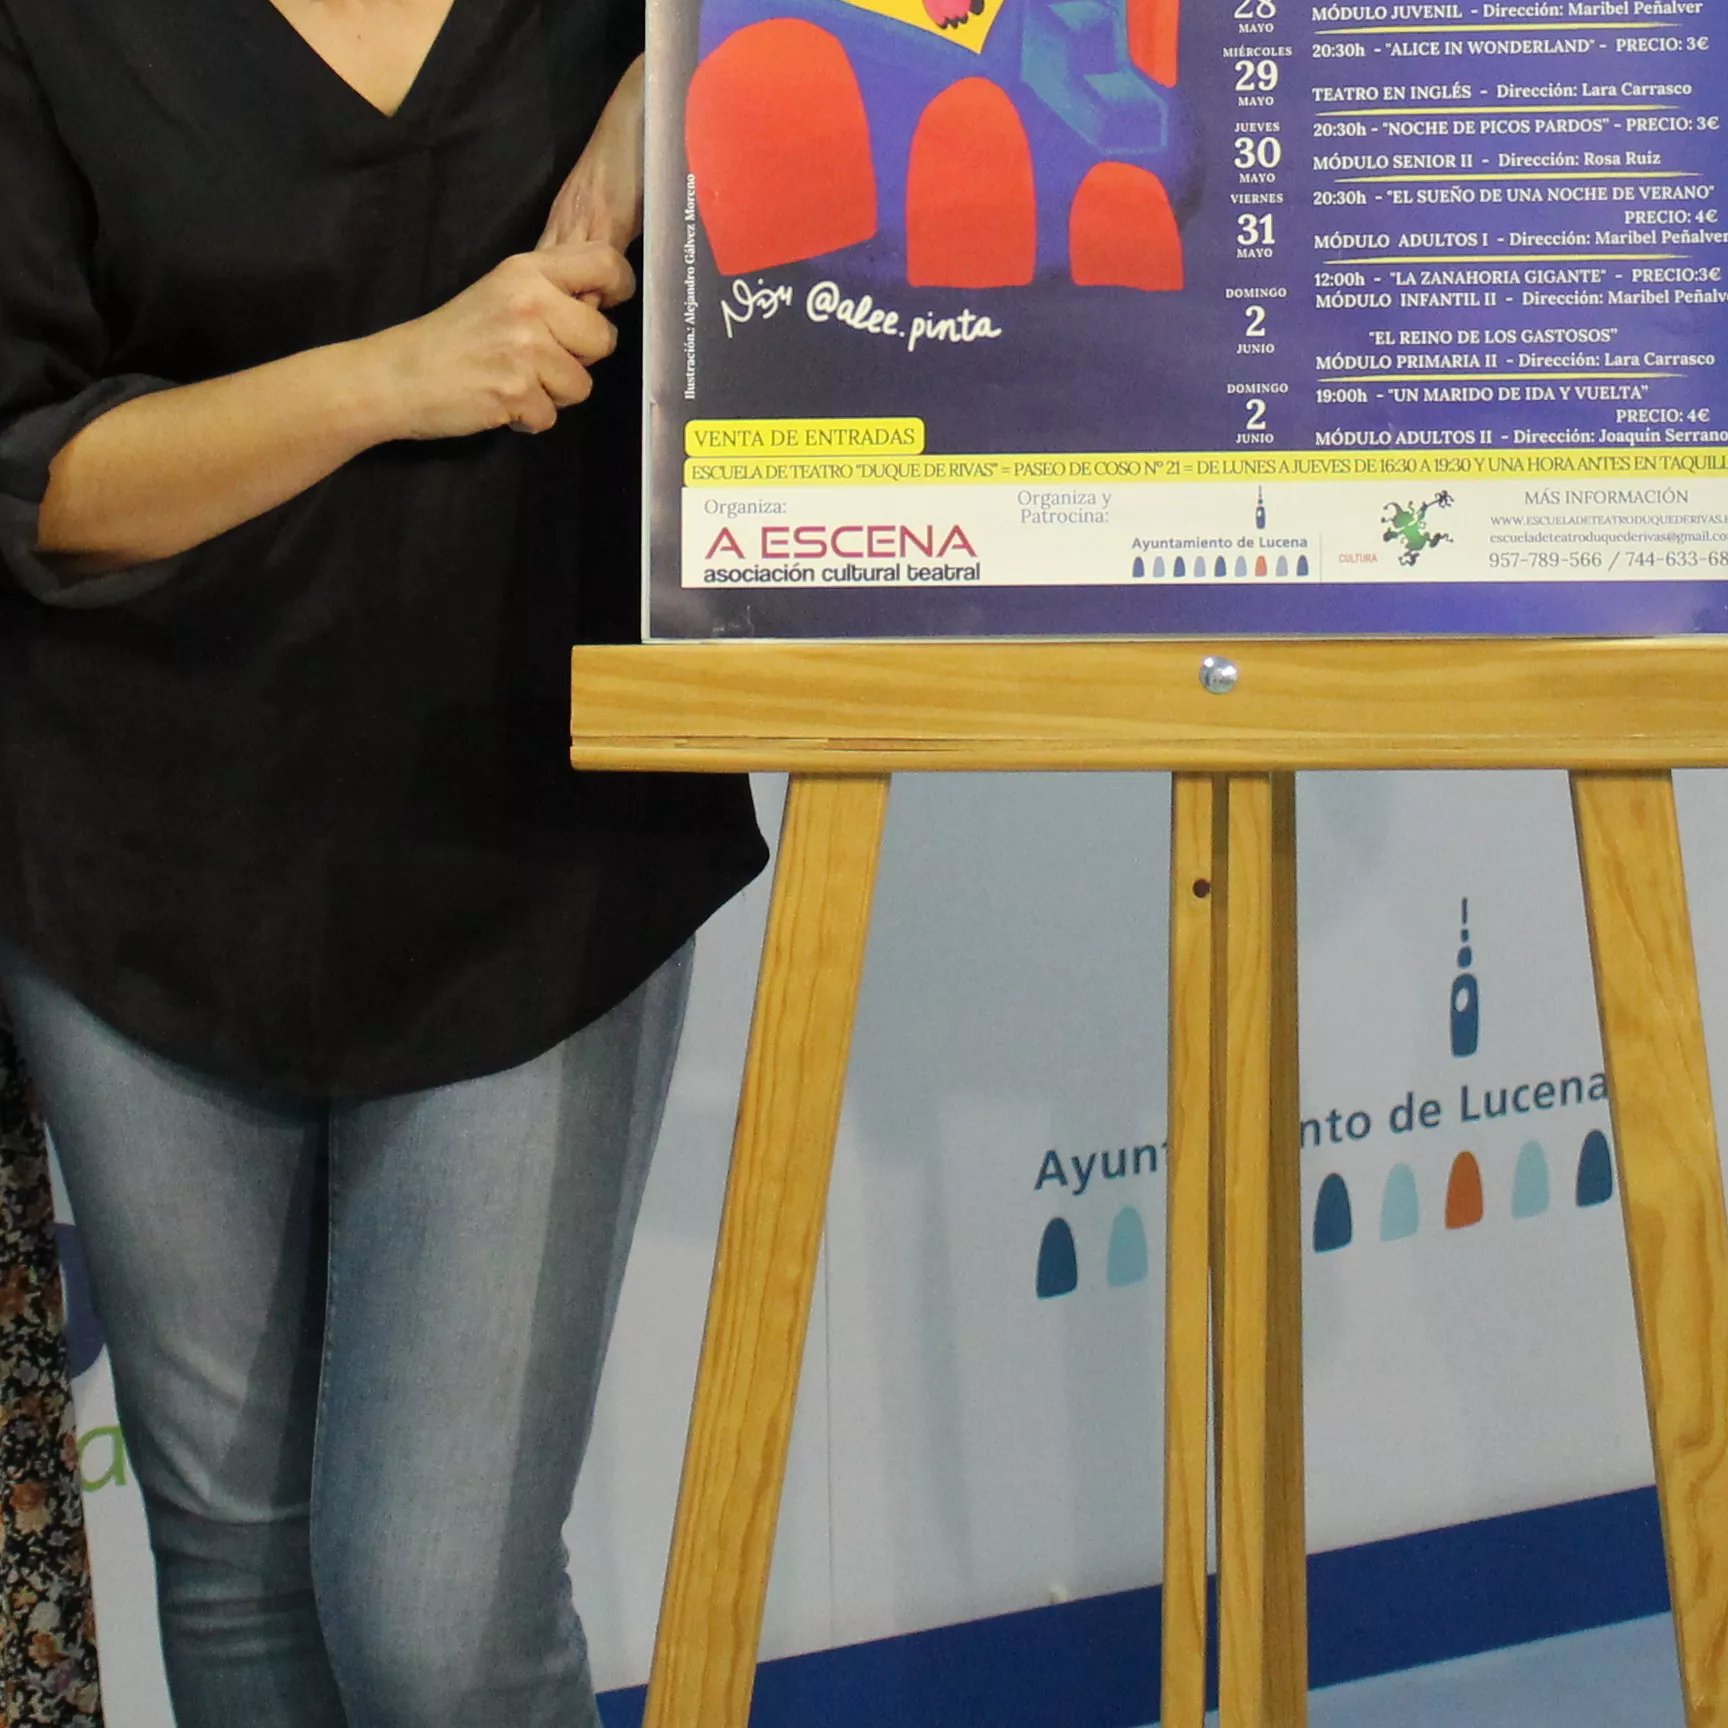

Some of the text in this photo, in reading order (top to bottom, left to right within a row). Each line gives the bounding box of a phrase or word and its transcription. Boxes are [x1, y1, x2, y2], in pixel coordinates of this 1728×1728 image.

[1238, 22, 1274, 33] MAYO
[1222, 44, 1292, 57] MIÉRCOLES
[1234, 59, 1278, 90] 29
[1238, 96, 1274, 106] MAYO
[1233, 121, 1279, 132] JUEVES
[1234, 136, 1281, 168] 30
[1239, 172, 1275, 183] MAYO
[684, 173, 695, 220] Moreno
[1230, 193, 1283, 203] VIERNES
[1237, 213, 1275, 245] 31
[683, 223, 695, 264] Gálvez
[1236, 247, 1272, 258] MAYO
[683, 266, 698, 324] Alejandro
[1225, 287, 1286, 298] DOMINGO
[1245, 305, 1265, 336] 2
[1368, 327, 1617, 345] "EL REINO DE LOS GASTOSOS"
[1236, 343, 1274, 353] JUNIO
[1226, 382, 1288, 393] DOMINGO
[1246, 398, 1265, 430] 2
[694, 427, 914, 447] VENTA DE ENTRADAS
[1235, 433, 1274, 443] JUNIO
[691, 465, 762, 479] ESCUELA
[765, 464, 787, 479] DE
[789, 463, 853, 478] TEATRO
[855, 463, 920, 480] "DUQUE
[923, 463, 945, 477] DE
[948, 462, 998, 476] RIVAS"
[1014, 461, 1066, 476] PASEO
[1068, 461, 1091, 475] DE
[1093, 460, 1141, 475] COSO
[1165, 459, 1179, 474] 21
[1197, 460, 1219, 474] DE
[1222, 459, 1276, 474] LUNES
[1278, 459, 1289, 473] A
[1291, 458, 1351, 473] JUEVES
[1354, 458, 1377, 473] DE
[1380, 458, 1417, 473] 16:30
[1419, 458, 1431, 472] A
[1434, 457, 1471, 472] 19:30
[1473, 457, 1485, 471] Y
[1488, 456, 1524, 471] UNA
[1527, 456, 1574, 471] HORA
[1576, 455, 1631, 470] ANTES
[1634, 455, 1656, 470] EN
[1017, 488, 1111, 510] Organiza y
[1524, 486, 1688, 504] MÁS INFORMACIÓN
[704, 498, 786, 518] Organiza:
[1020, 506, 1108, 524] Patrocina:
[705, 524, 977, 559] A ESCENA
[1131, 535, 1307, 552] Ayuntamiento de Lucena
[1488, 550, 1602, 567] 957-789-566
[1607, 550, 1620, 571] /
[703, 562, 980, 583] asociación cultural teatral
[1389, 1091, 1441, 1134] de
